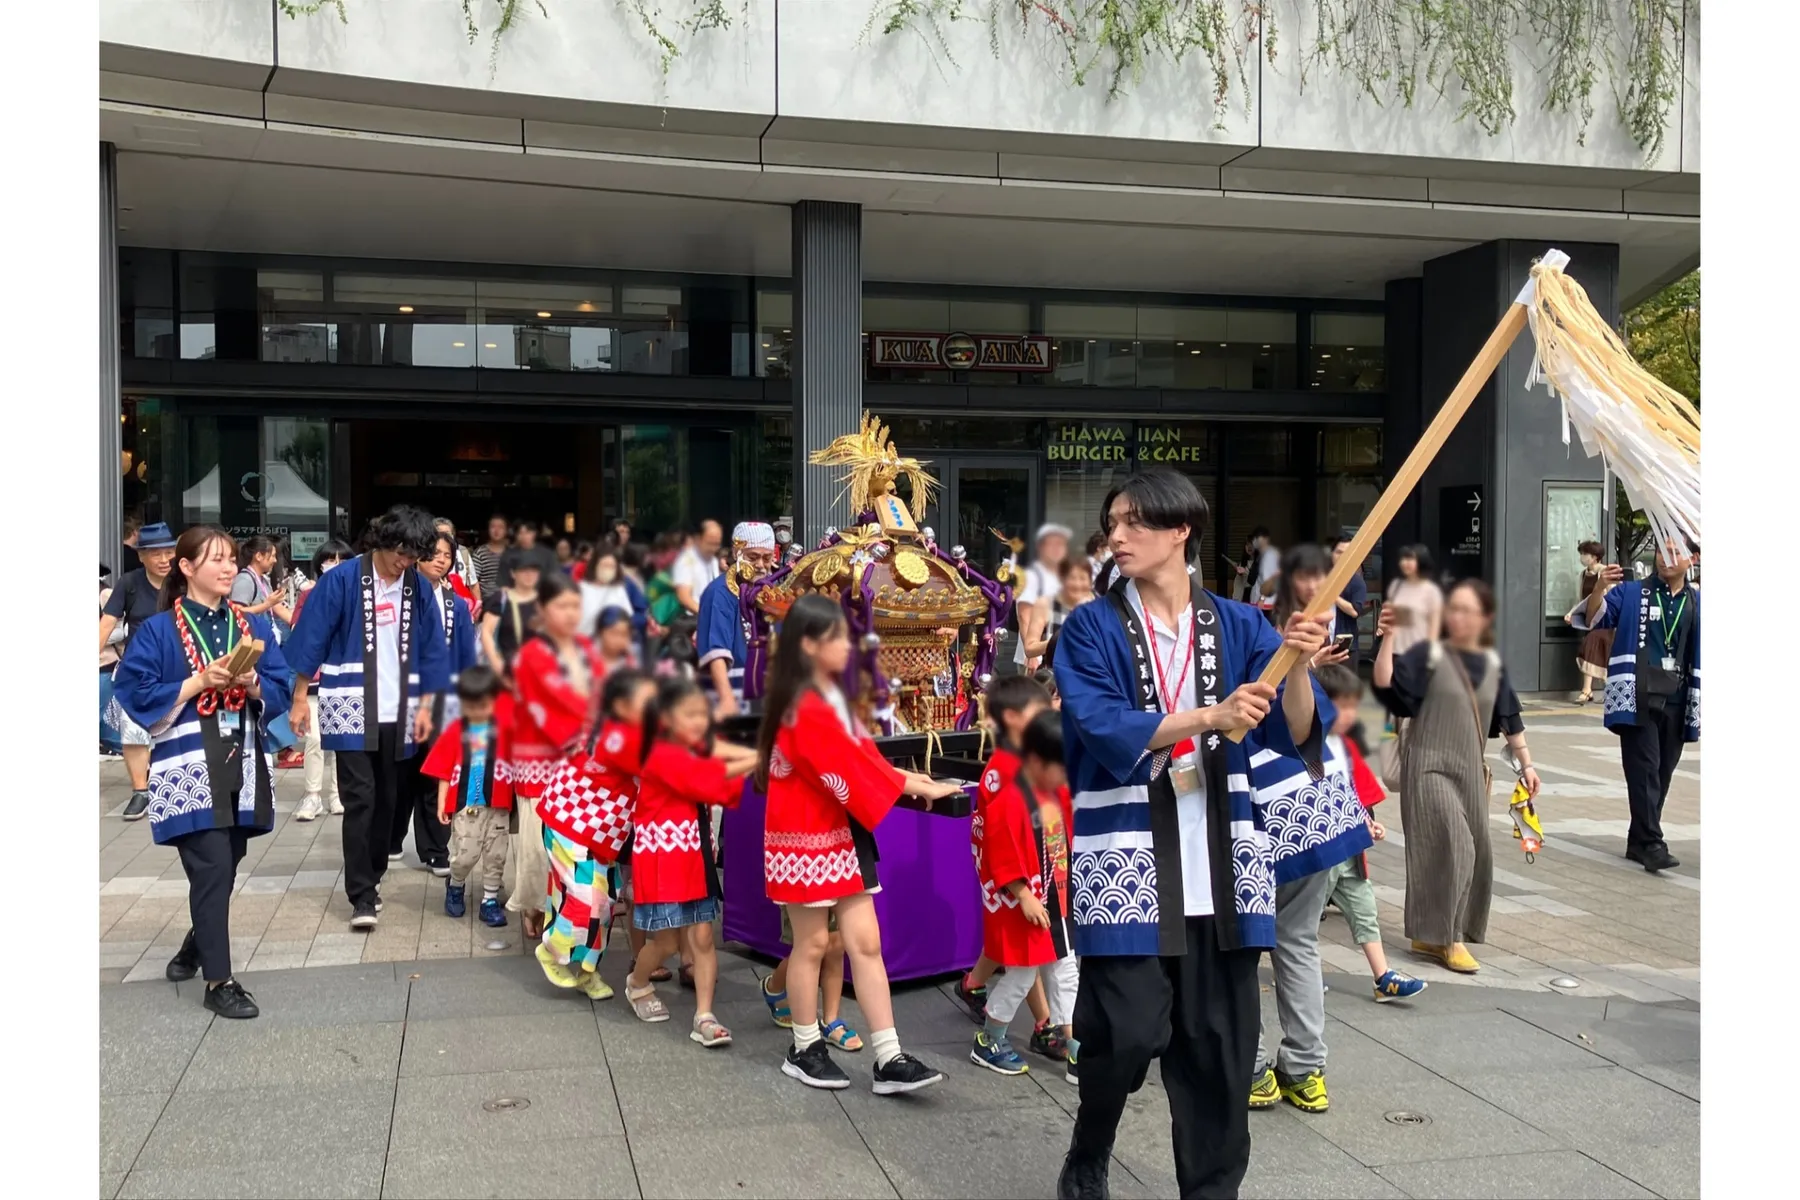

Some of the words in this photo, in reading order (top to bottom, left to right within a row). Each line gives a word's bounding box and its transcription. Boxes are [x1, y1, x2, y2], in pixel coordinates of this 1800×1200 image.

[881, 339, 934, 362] KUA
[1047, 445, 1126, 461] BURGER
[363, 589, 375, 652] 東京ソラマチ
[1199, 633, 1221, 751] 東京ソラチ
[1386, 982, 1399, 994] N
